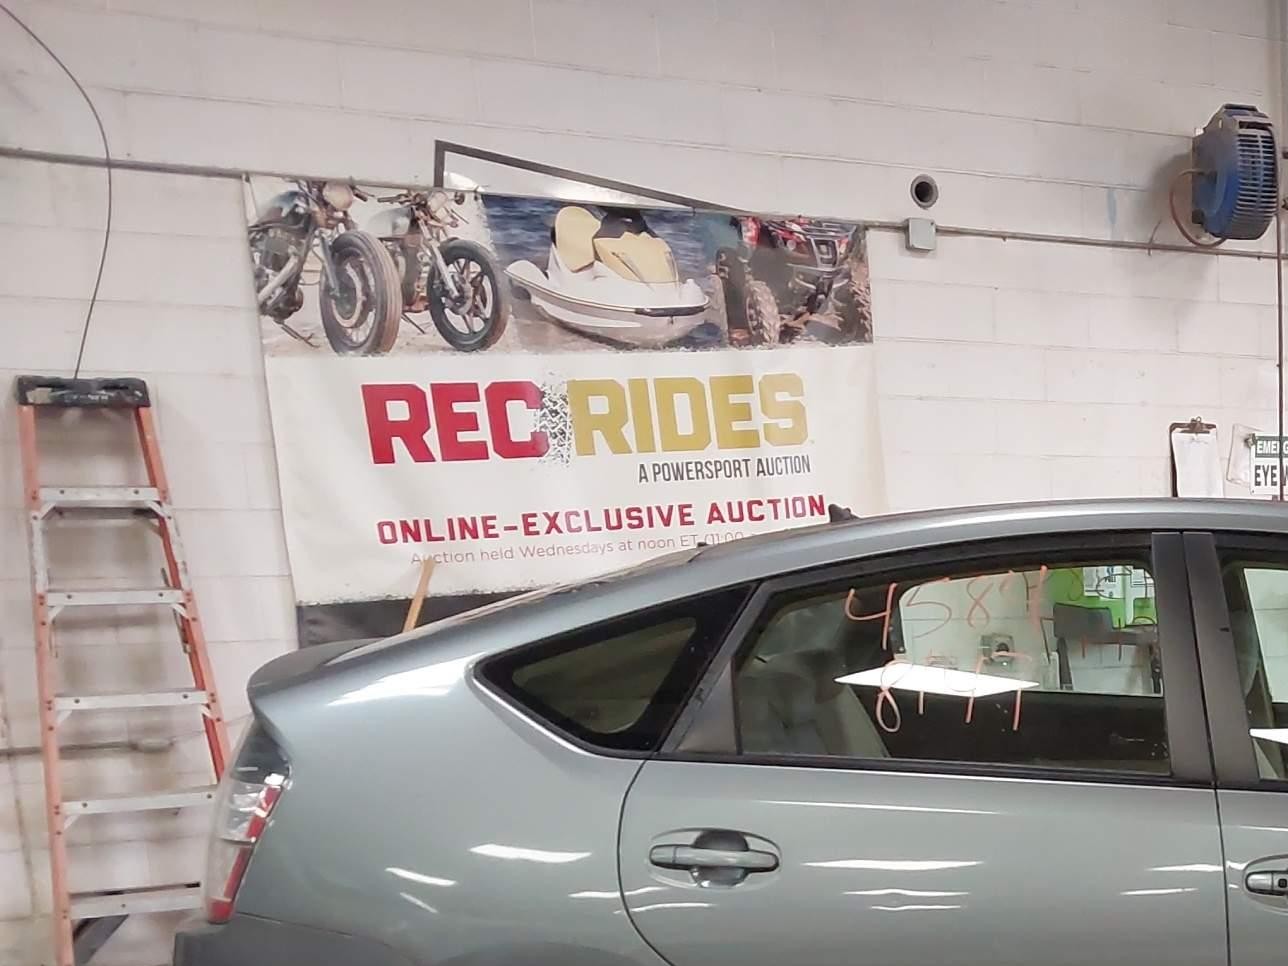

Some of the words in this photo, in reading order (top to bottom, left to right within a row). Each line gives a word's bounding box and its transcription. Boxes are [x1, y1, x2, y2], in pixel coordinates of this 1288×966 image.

[361, 380, 549, 464] REC
[567, 373, 809, 456] RIDES
[638, 463, 648, 483] A
[652, 458, 750, 482] POWERSPORT
[756, 454, 811, 477] AUCTION
[1254, 464, 1277, 486] EYE
[377, 503, 694, 544] ONLINE-EXCLUSIVE
[707, 494, 825, 525] AUCTION
[481, 546, 514, 560] held
[519, 541, 614, 558] Wednesdays
[618, 541, 632, 551] at
[638, 536, 675, 550] noon
[680, 533, 698, 547] ET
